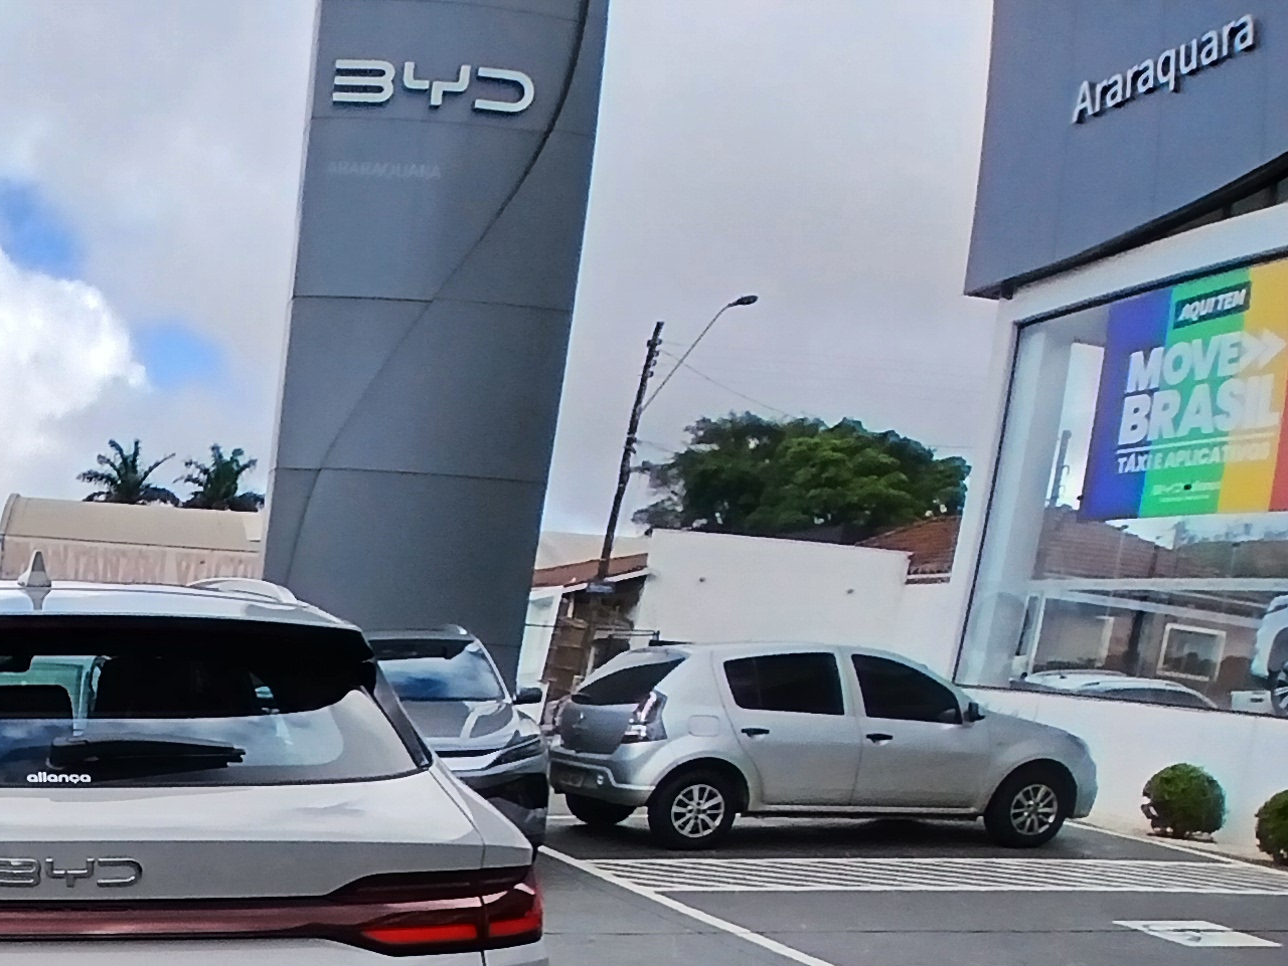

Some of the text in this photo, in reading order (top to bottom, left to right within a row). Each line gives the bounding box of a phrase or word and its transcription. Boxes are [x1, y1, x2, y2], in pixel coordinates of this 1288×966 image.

[332, 58, 535, 113] BYD
[1071, 14, 1255, 123] Araraquara
[1180, 288, 1247, 321] AQUI TEM
[1125, 331, 1243, 393] MOVE
[1117, 374, 1280, 445] BRASIL
[26, 771, 92, 784] aliança
